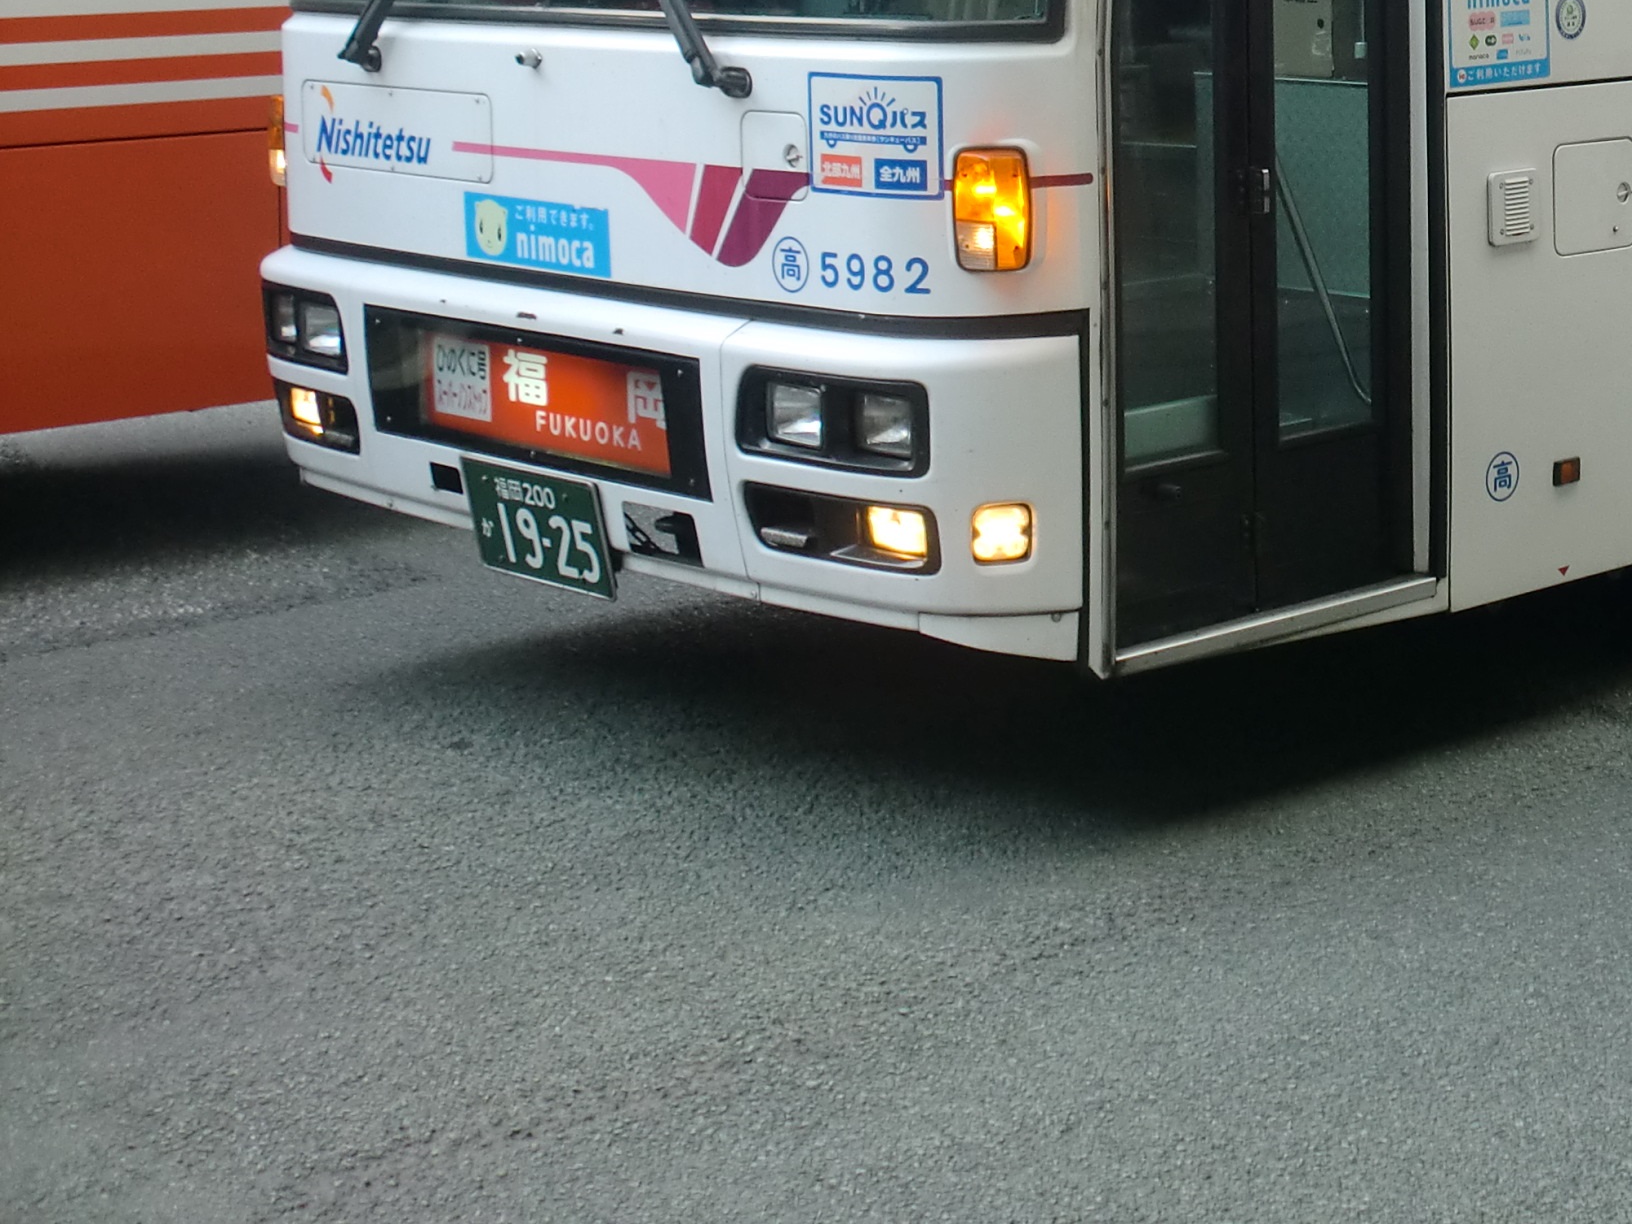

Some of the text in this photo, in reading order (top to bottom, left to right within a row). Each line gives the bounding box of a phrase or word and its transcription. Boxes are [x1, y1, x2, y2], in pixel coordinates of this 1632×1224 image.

[316, 114, 431, 165] Nishitetsu
[879, 165, 921, 184] 全九州
[515, 224, 596, 269] nimoca
[820, 251, 932, 295] 5982
[535, 409, 643, 452] FUKUOKA
[496, 501, 601, 584] 19-25
